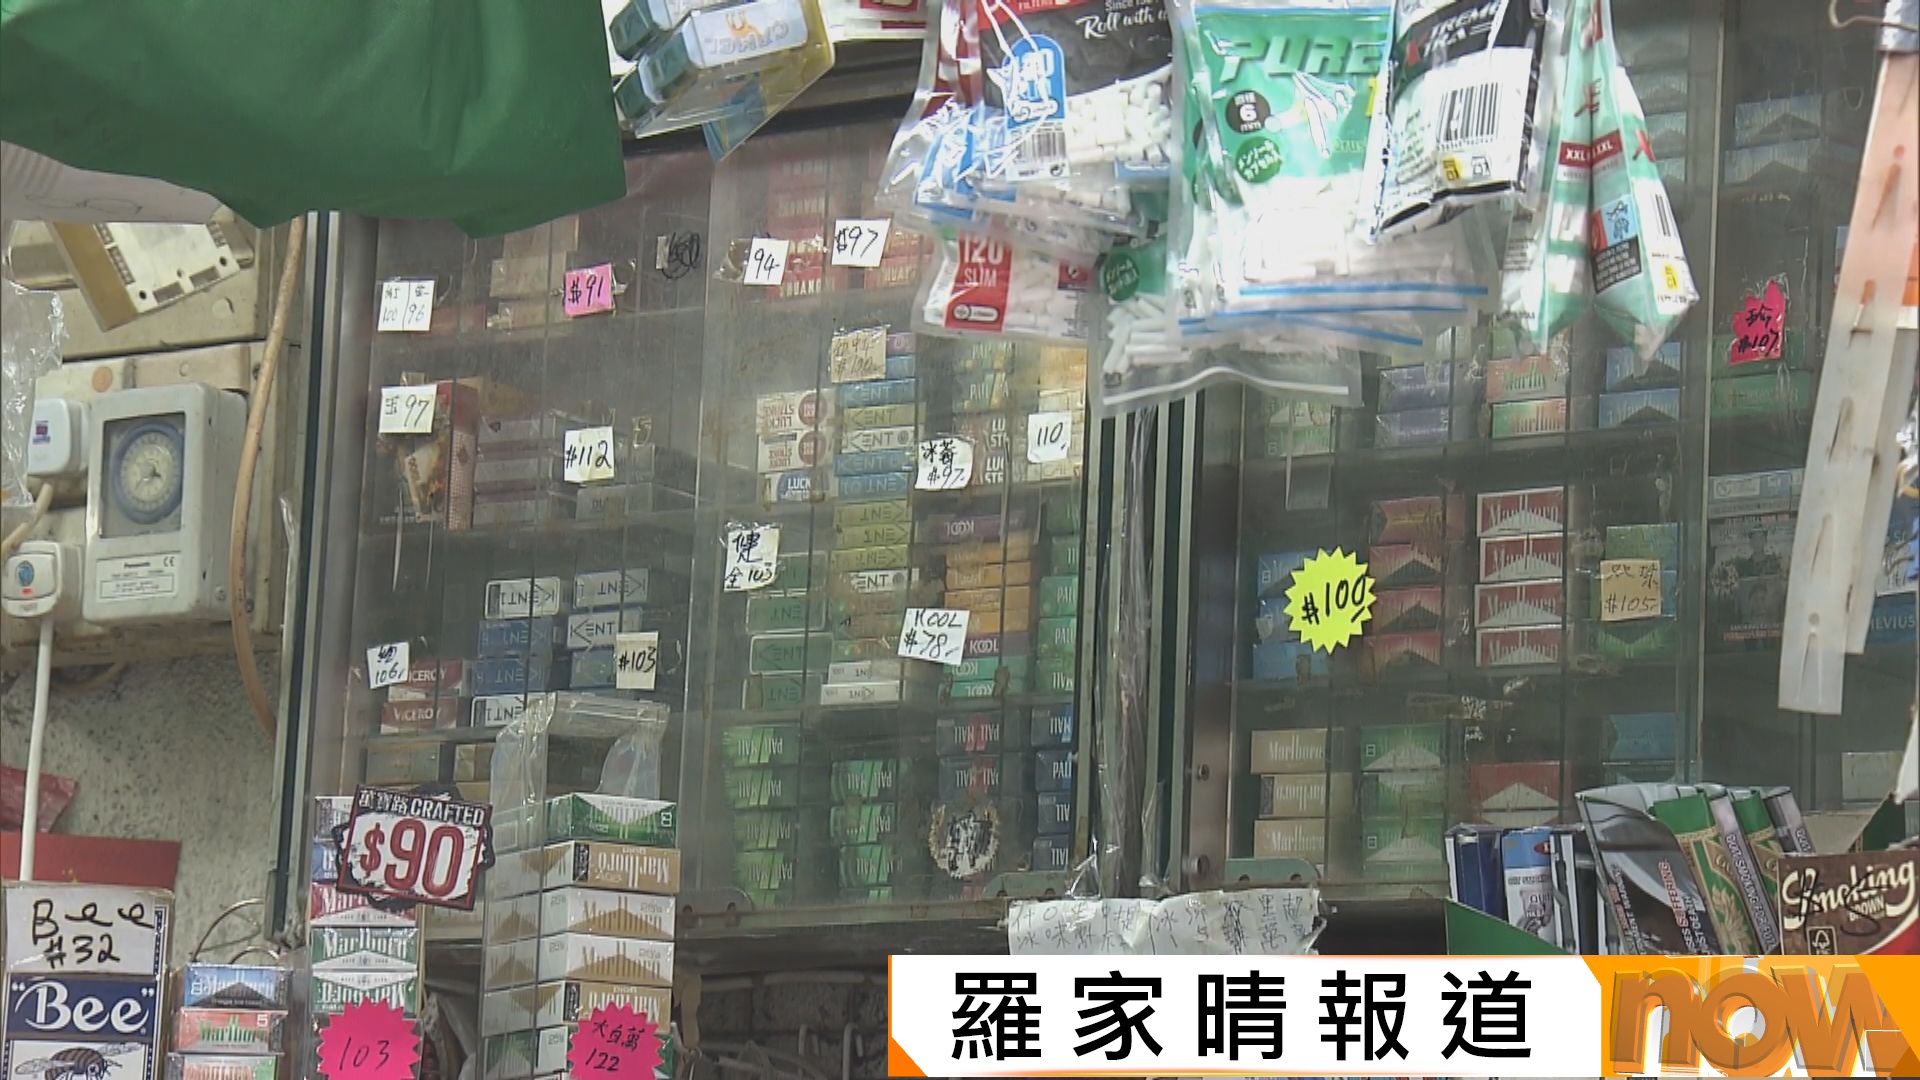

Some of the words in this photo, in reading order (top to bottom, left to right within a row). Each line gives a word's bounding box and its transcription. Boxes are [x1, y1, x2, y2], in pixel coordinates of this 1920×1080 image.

[1075, 15, 1119, 39] Roll
[1123, 10, 1154, 26] with
[1217, 35, 1383, 83] PURE
[1239, 104, 1256, 121] 6
[964, 268, 997, 289] SLIM
[569, 617, 616, 646] KENT
[914, 609, 962, 628] KOOL
[969, 638, 1000, 655] KOOL
[394, 704, 441, 722] VICEROY
[410, 798, 485, 827] CRAFTED
[359, 817, 465, 897] $90
[1781, 861, 1915, 930] Smoking
[32, 899, 156, 946] Bee
[44, 933, 121, 970] #32
[338, 1035, 391, 1072] 103
[585, 1047, 620, 1072] 122
